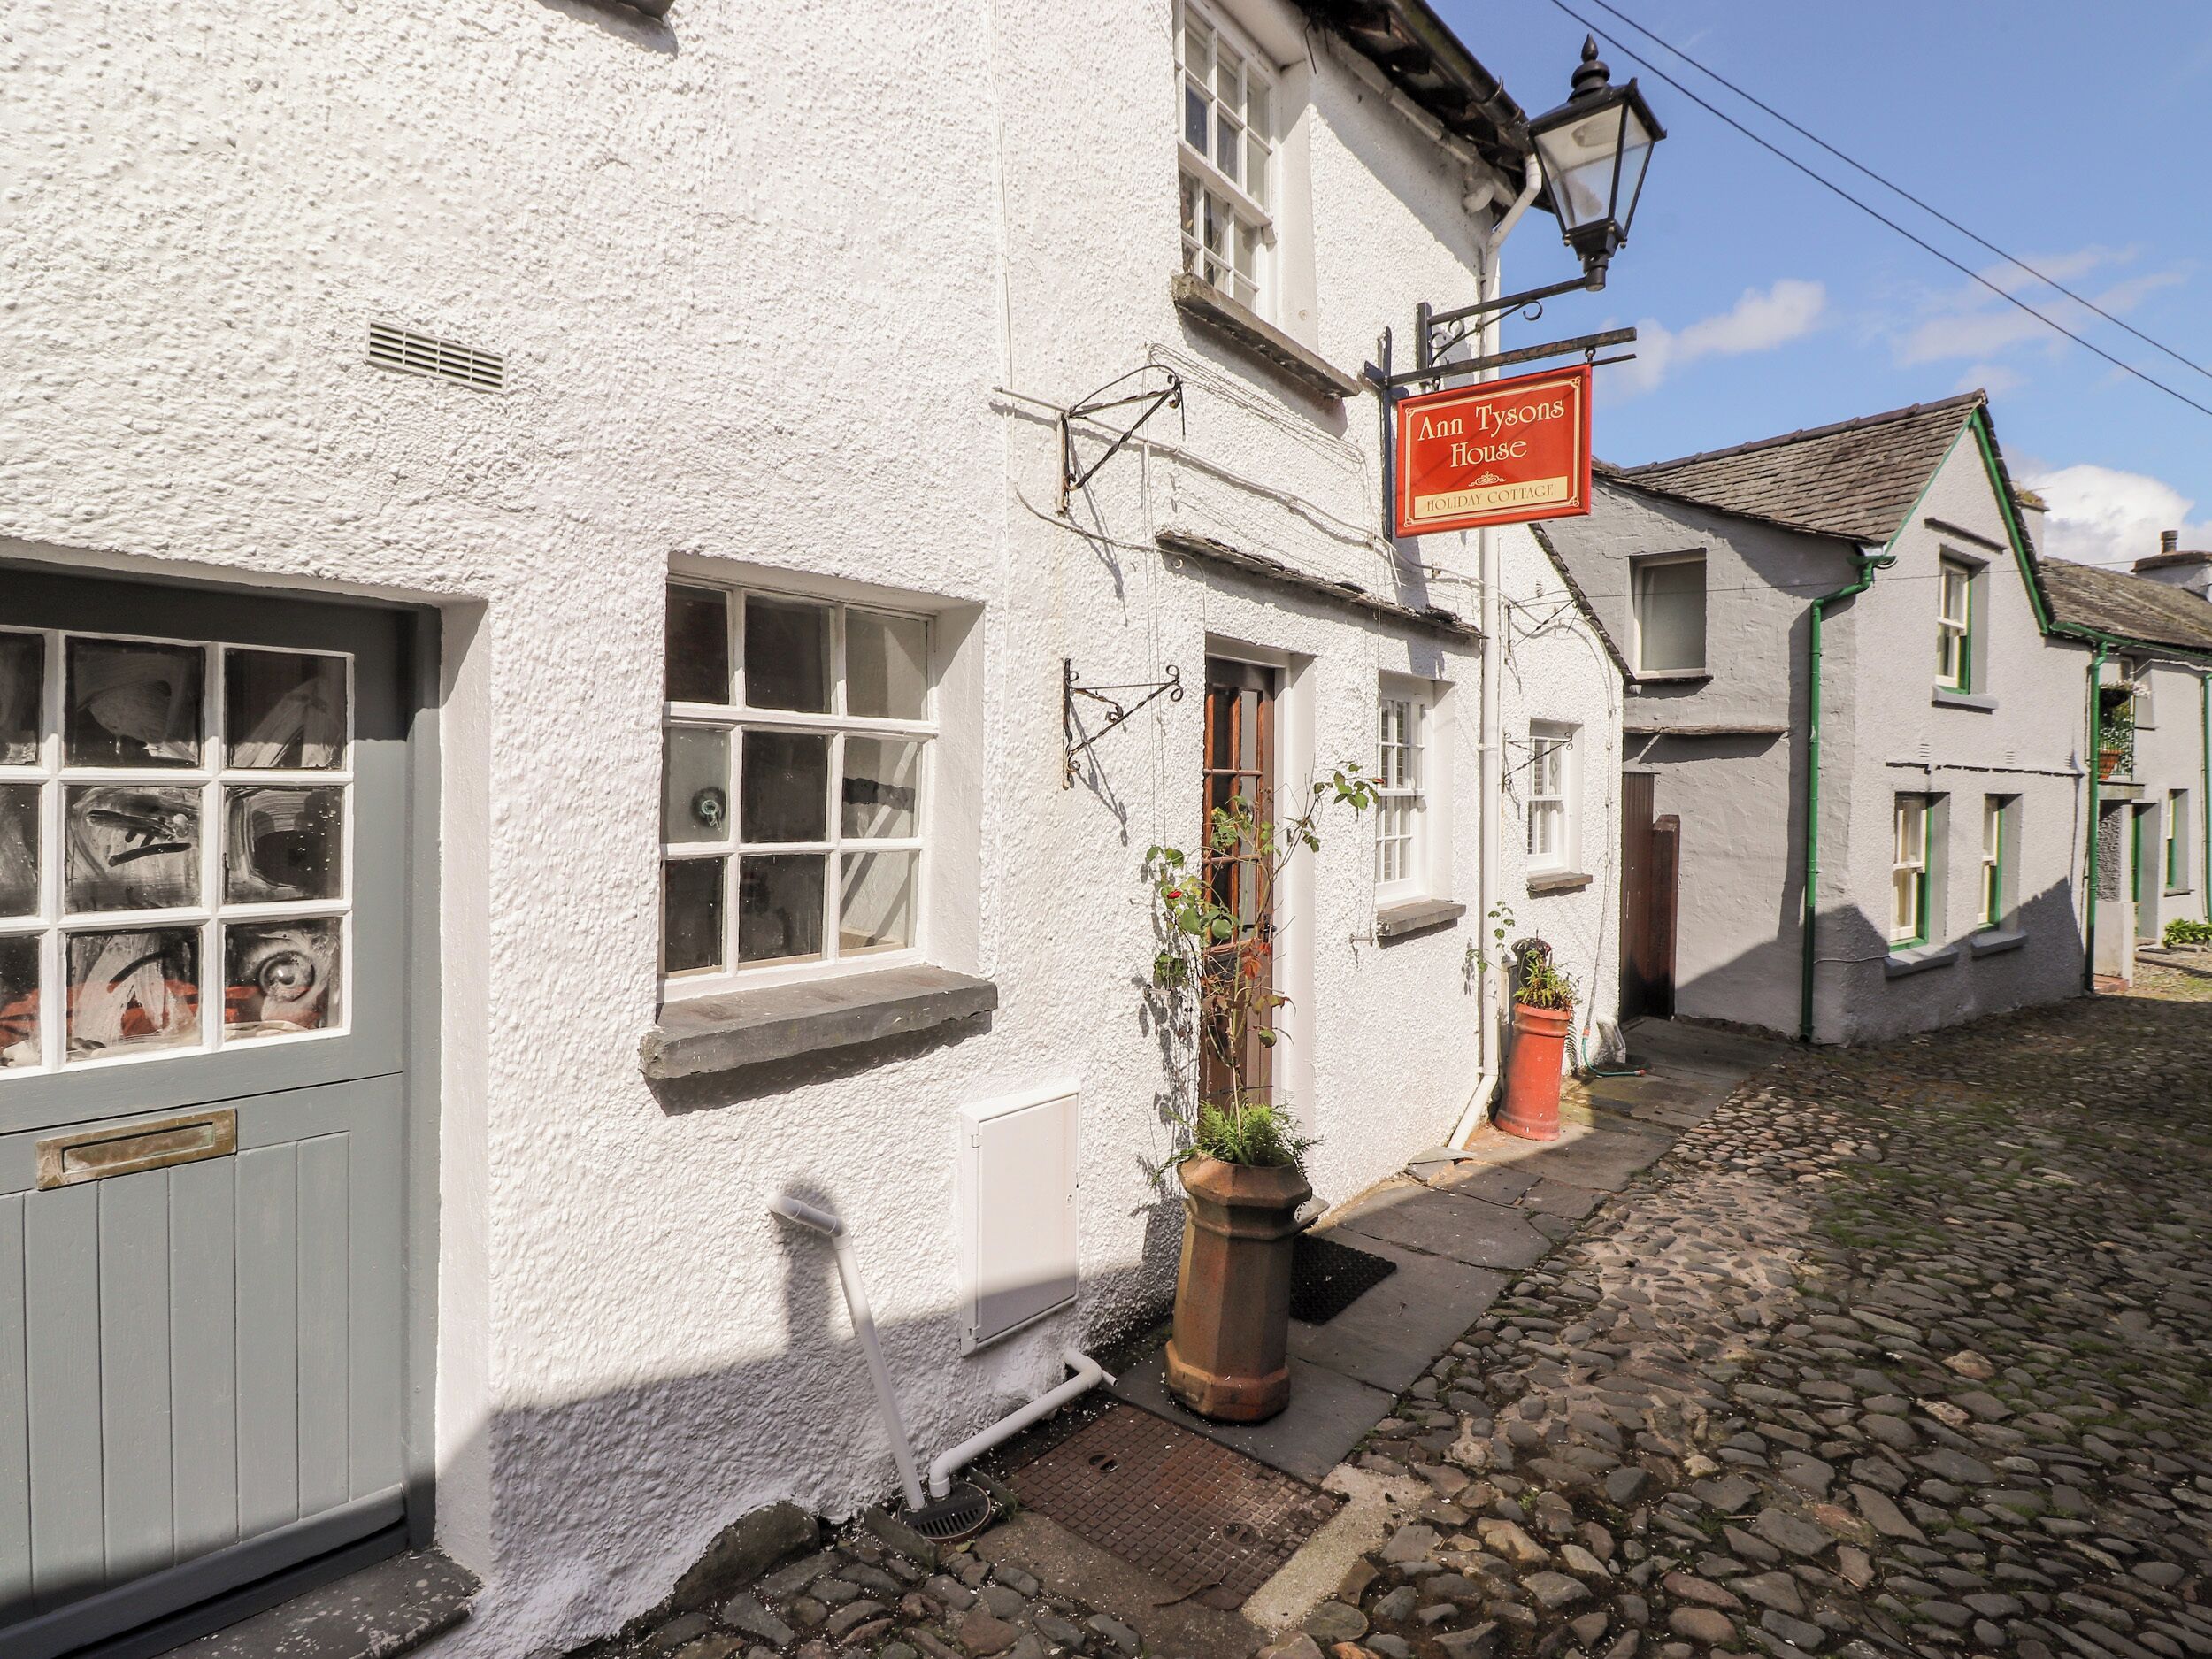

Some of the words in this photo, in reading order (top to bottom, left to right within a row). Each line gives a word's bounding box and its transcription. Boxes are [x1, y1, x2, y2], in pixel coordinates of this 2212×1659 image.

[1417, 416, 1463, 442] Ann
[1475, 399, 1565, 438] Tysons
[1450, 440, 1527, 468] House
[1426, 494, 1483, 512] HOLIDAY
[1487, 484, 1554, 503] COTTAGE
